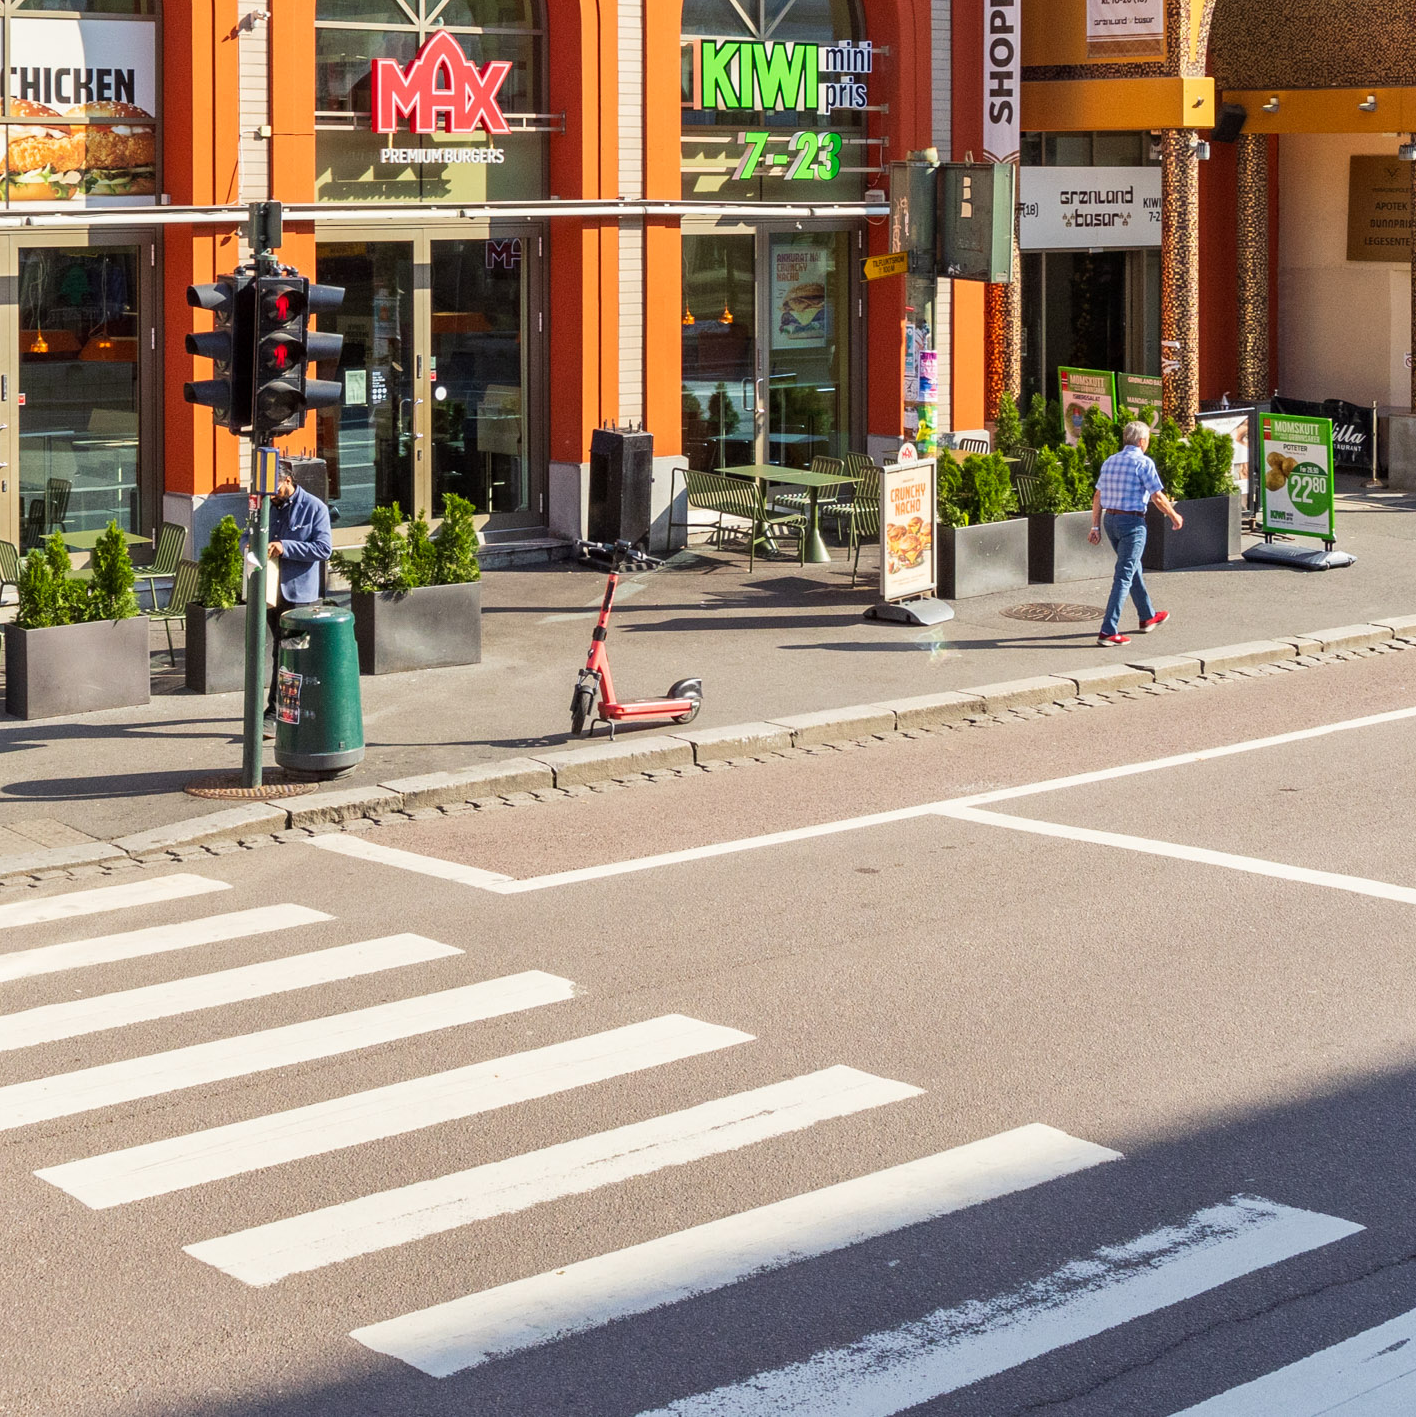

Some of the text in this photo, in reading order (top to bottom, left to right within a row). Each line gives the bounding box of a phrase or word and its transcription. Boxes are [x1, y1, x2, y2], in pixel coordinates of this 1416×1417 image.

[372, 29, 513, 134] MAX
[700, 40, 872, 110] KIWI mini
[0, 66, 136, 105] CHICKEN
[824, 76, 868, 115] pris
[380, 148, 505, 164] PREMIUM BURGERS
[1374, 202, 1408, 211] APOTEK
[1074, 209, 1120, 228] basar
[1149, 211, 1162, 222] 7-2
[1364, 237, 1411, 247] LEGESENTE
[1274, 421, 1320, 436] MOMSKUTT
[1332, 422, 1367, 445] illa
[902, 447, 914, 460] MAX
[1283, 443, 1308, 452] POTETER
[1334, 443, 1362, 453] TAURANT
[890, 482, 927, 503] CRUNCHY
[894, 498, 922, 517] NACHO
